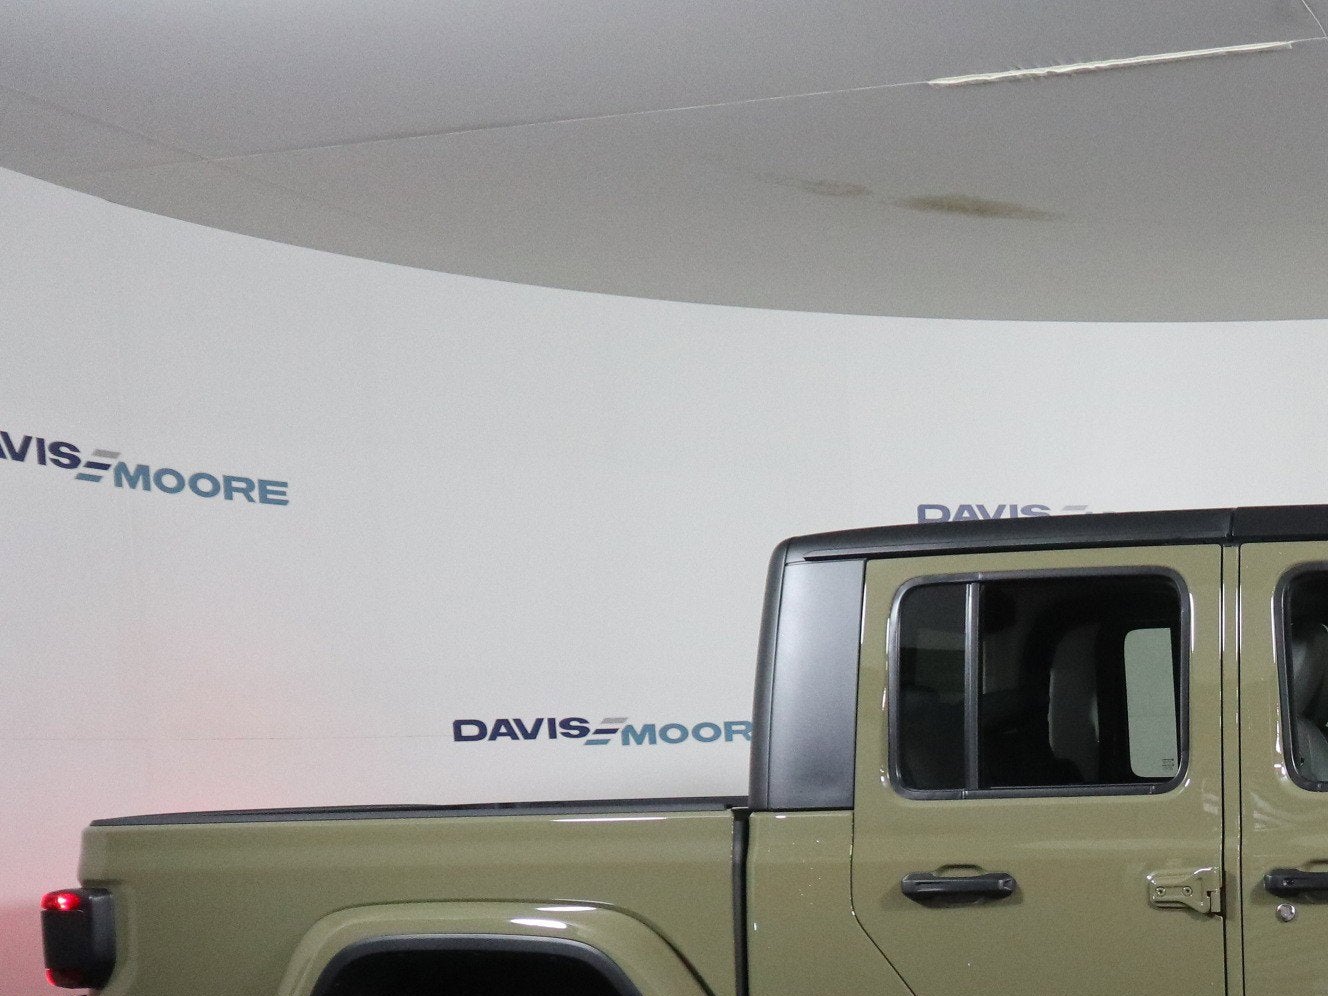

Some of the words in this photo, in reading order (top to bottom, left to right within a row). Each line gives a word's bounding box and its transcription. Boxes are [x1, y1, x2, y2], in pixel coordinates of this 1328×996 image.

[0, 431, 82, 469] VIS
[113, 461, 289, 506] MOORE
[452, 717, 590, 742] DAVIS
